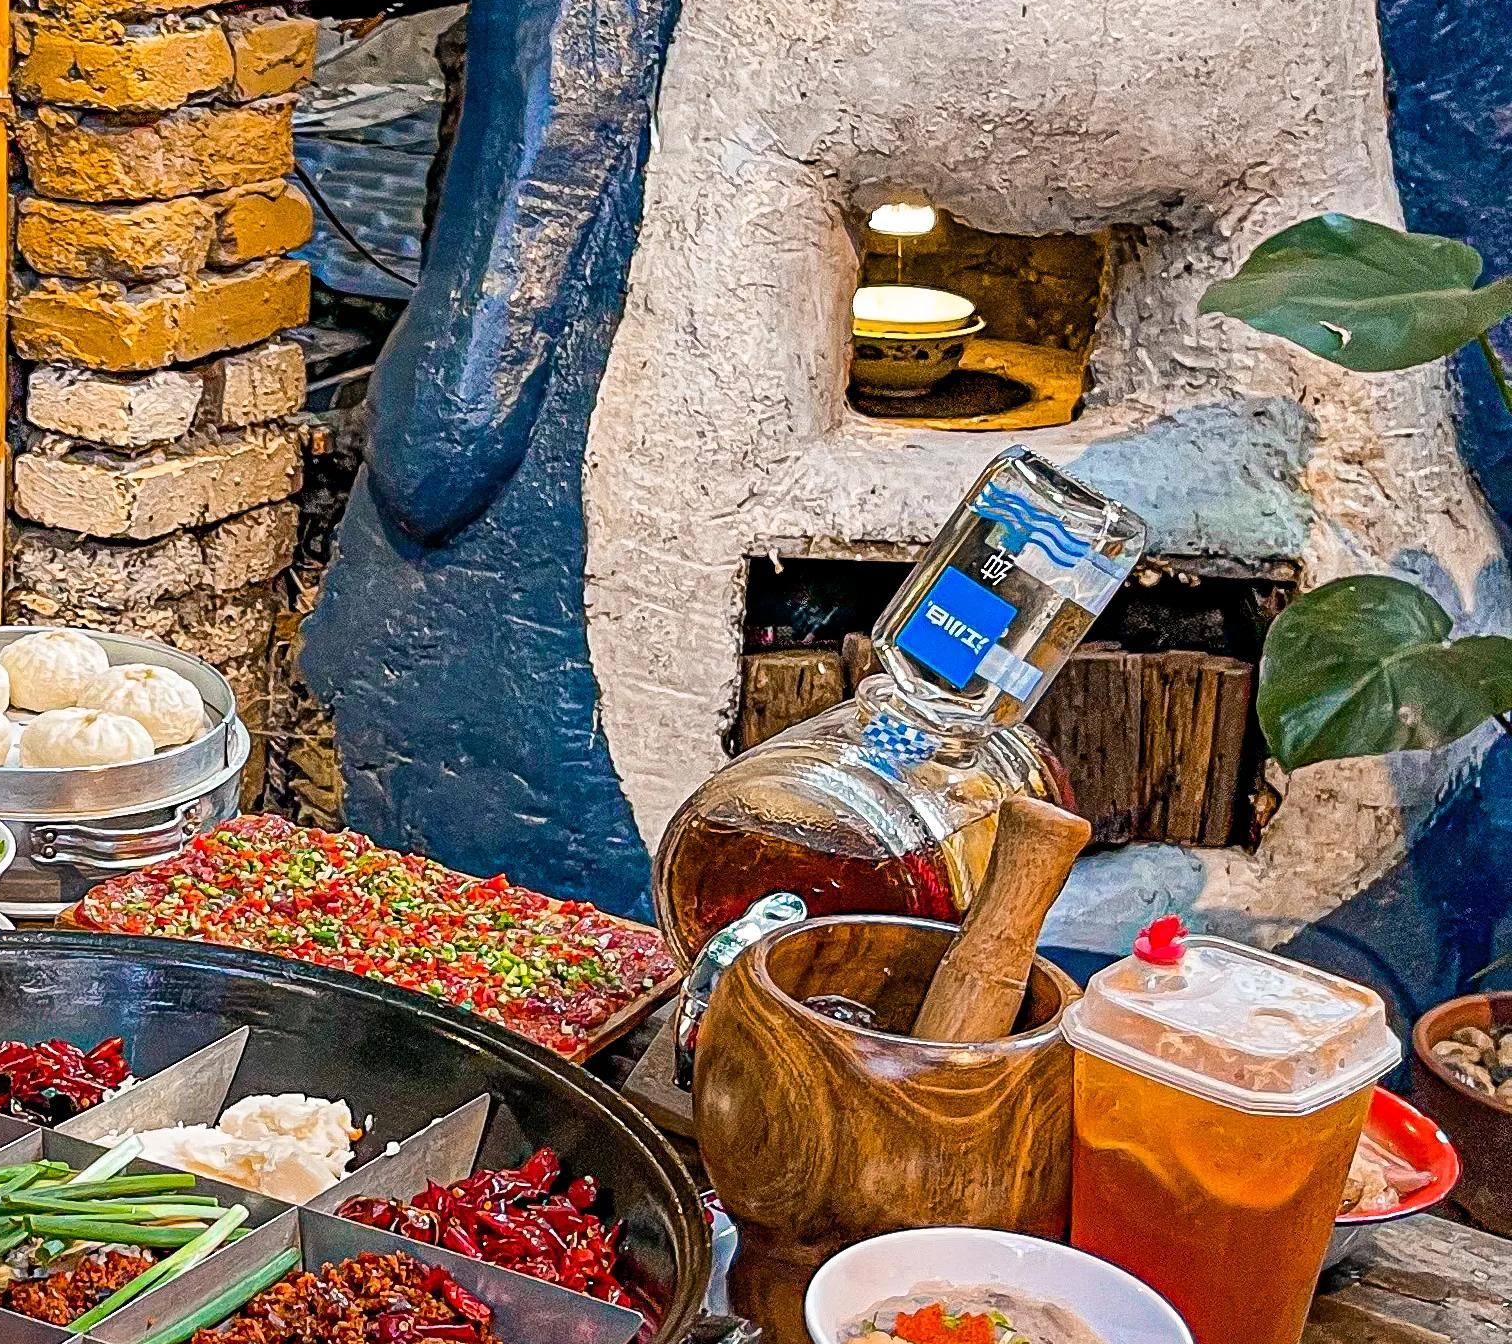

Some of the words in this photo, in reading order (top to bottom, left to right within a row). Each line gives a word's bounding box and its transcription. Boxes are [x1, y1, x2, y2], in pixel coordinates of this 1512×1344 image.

[980, 541, 1018, 586] 纯
[925, 600, 990, 656] 江小白
